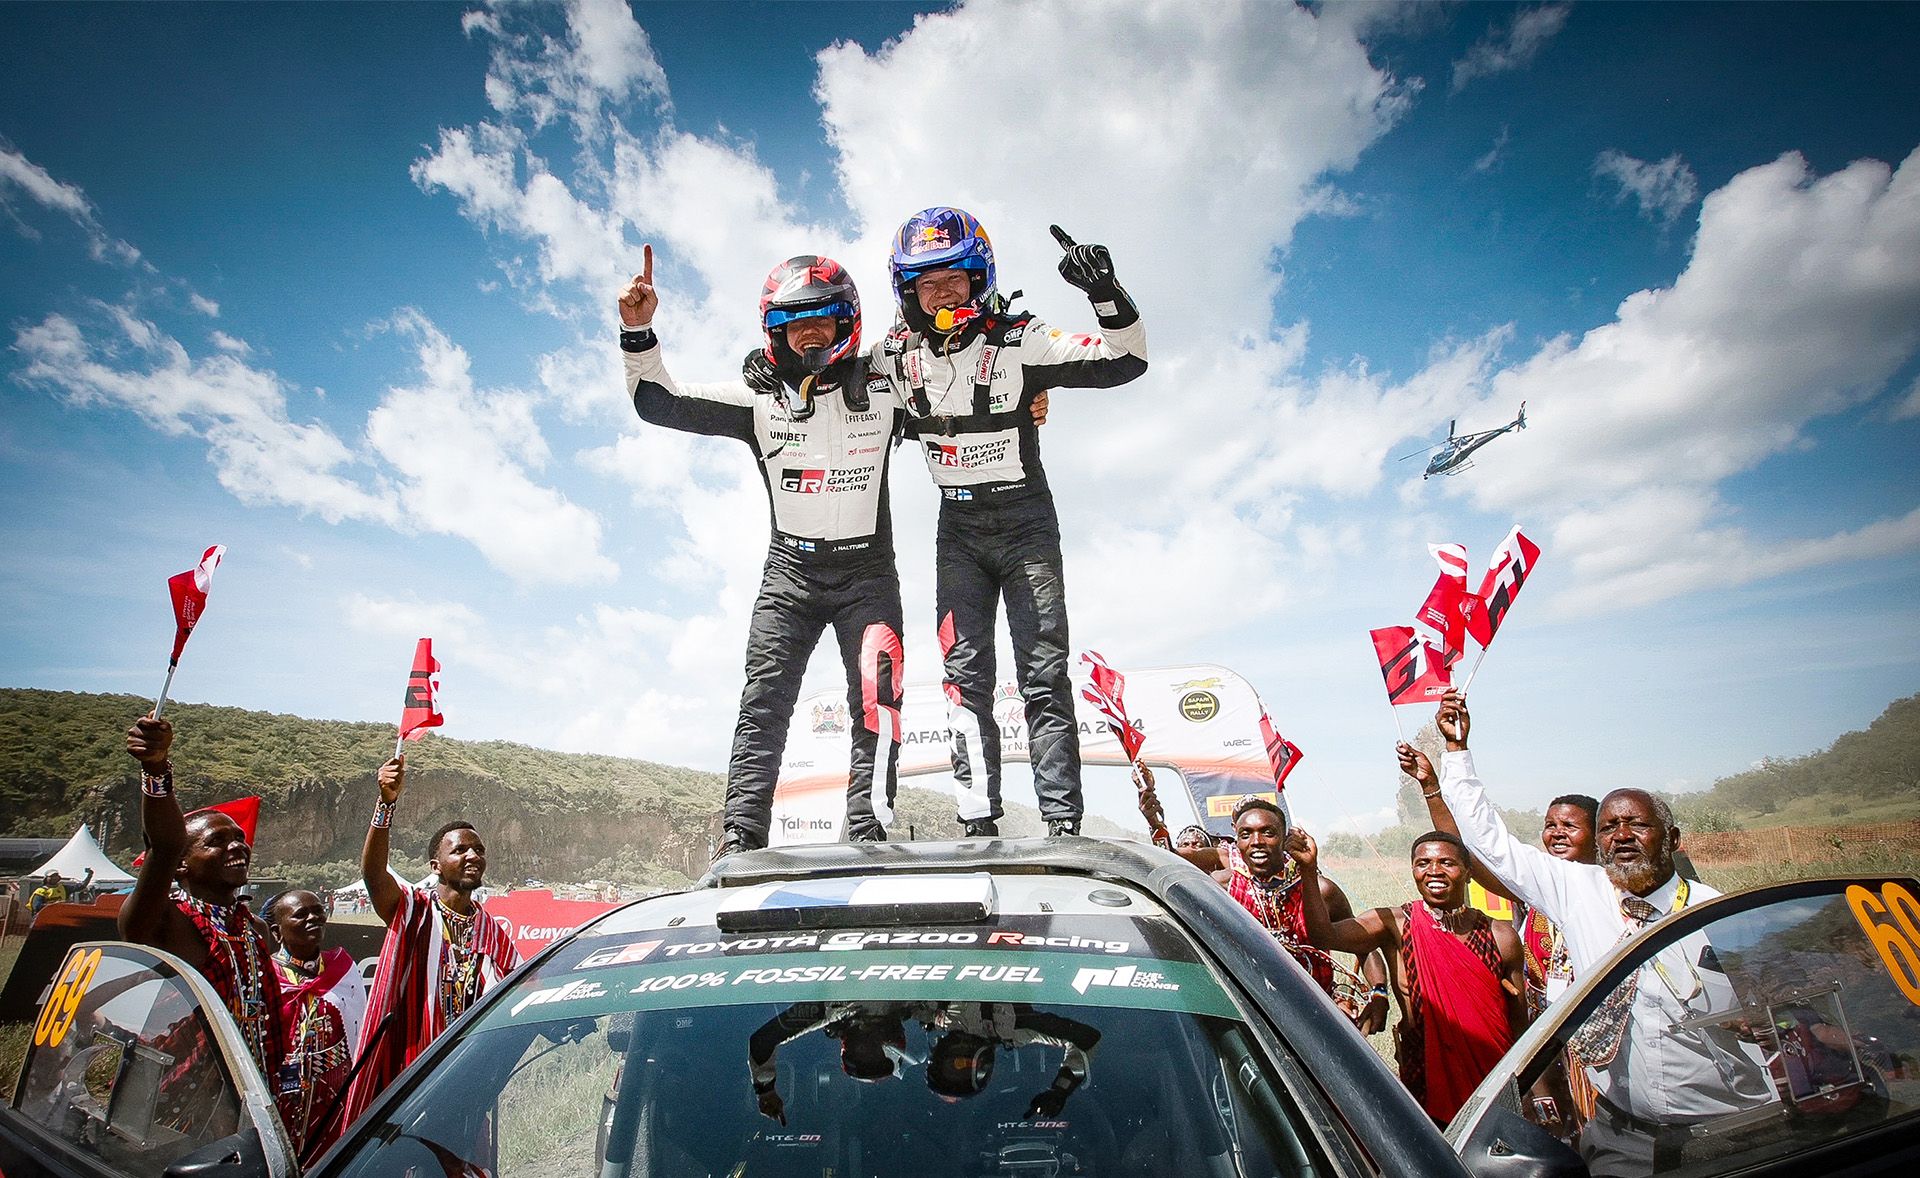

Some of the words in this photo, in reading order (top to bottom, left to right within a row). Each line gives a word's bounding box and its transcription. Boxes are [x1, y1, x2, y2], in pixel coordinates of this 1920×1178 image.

[1003, 328, 1023, 343] OMP
[980, 350, 993, 381] SIMPSON
[869, 379, 888, 391] OMP
[770, 431, 807, 442] UNIBET
[961, 438, 1011, 454] TOYOTA
[961, 447, 1006, 462] GAZOO
[961, 453, 1004, 469] Racing
[830, 466, 875, 477] TOYOTA
[782, 478, 822, 493] GR
[827, 475, 870, 486] GAZOO
[825, 484, 867, 493] Racing
[1190, 709, 1210, 717] RALLY
[902, 730, 951, 744] AFAR
[1223, 739, 1252, 747] WRC
[788, 760, 815, 768] WRC
[663, 935, 818, 956] TOYOTA
[827, 931, 979, 946] GAZOO
[987, 930, 1130, 954] Racing
[629, 971, 729, 994] 100%
[731, 964, 954, 985] FOSSIL-FREE
[955, 964, 1044, 983] FUEL
[1131, 981, 1180, 991] CHANGE
[35, 948, 102, 1047] 69
